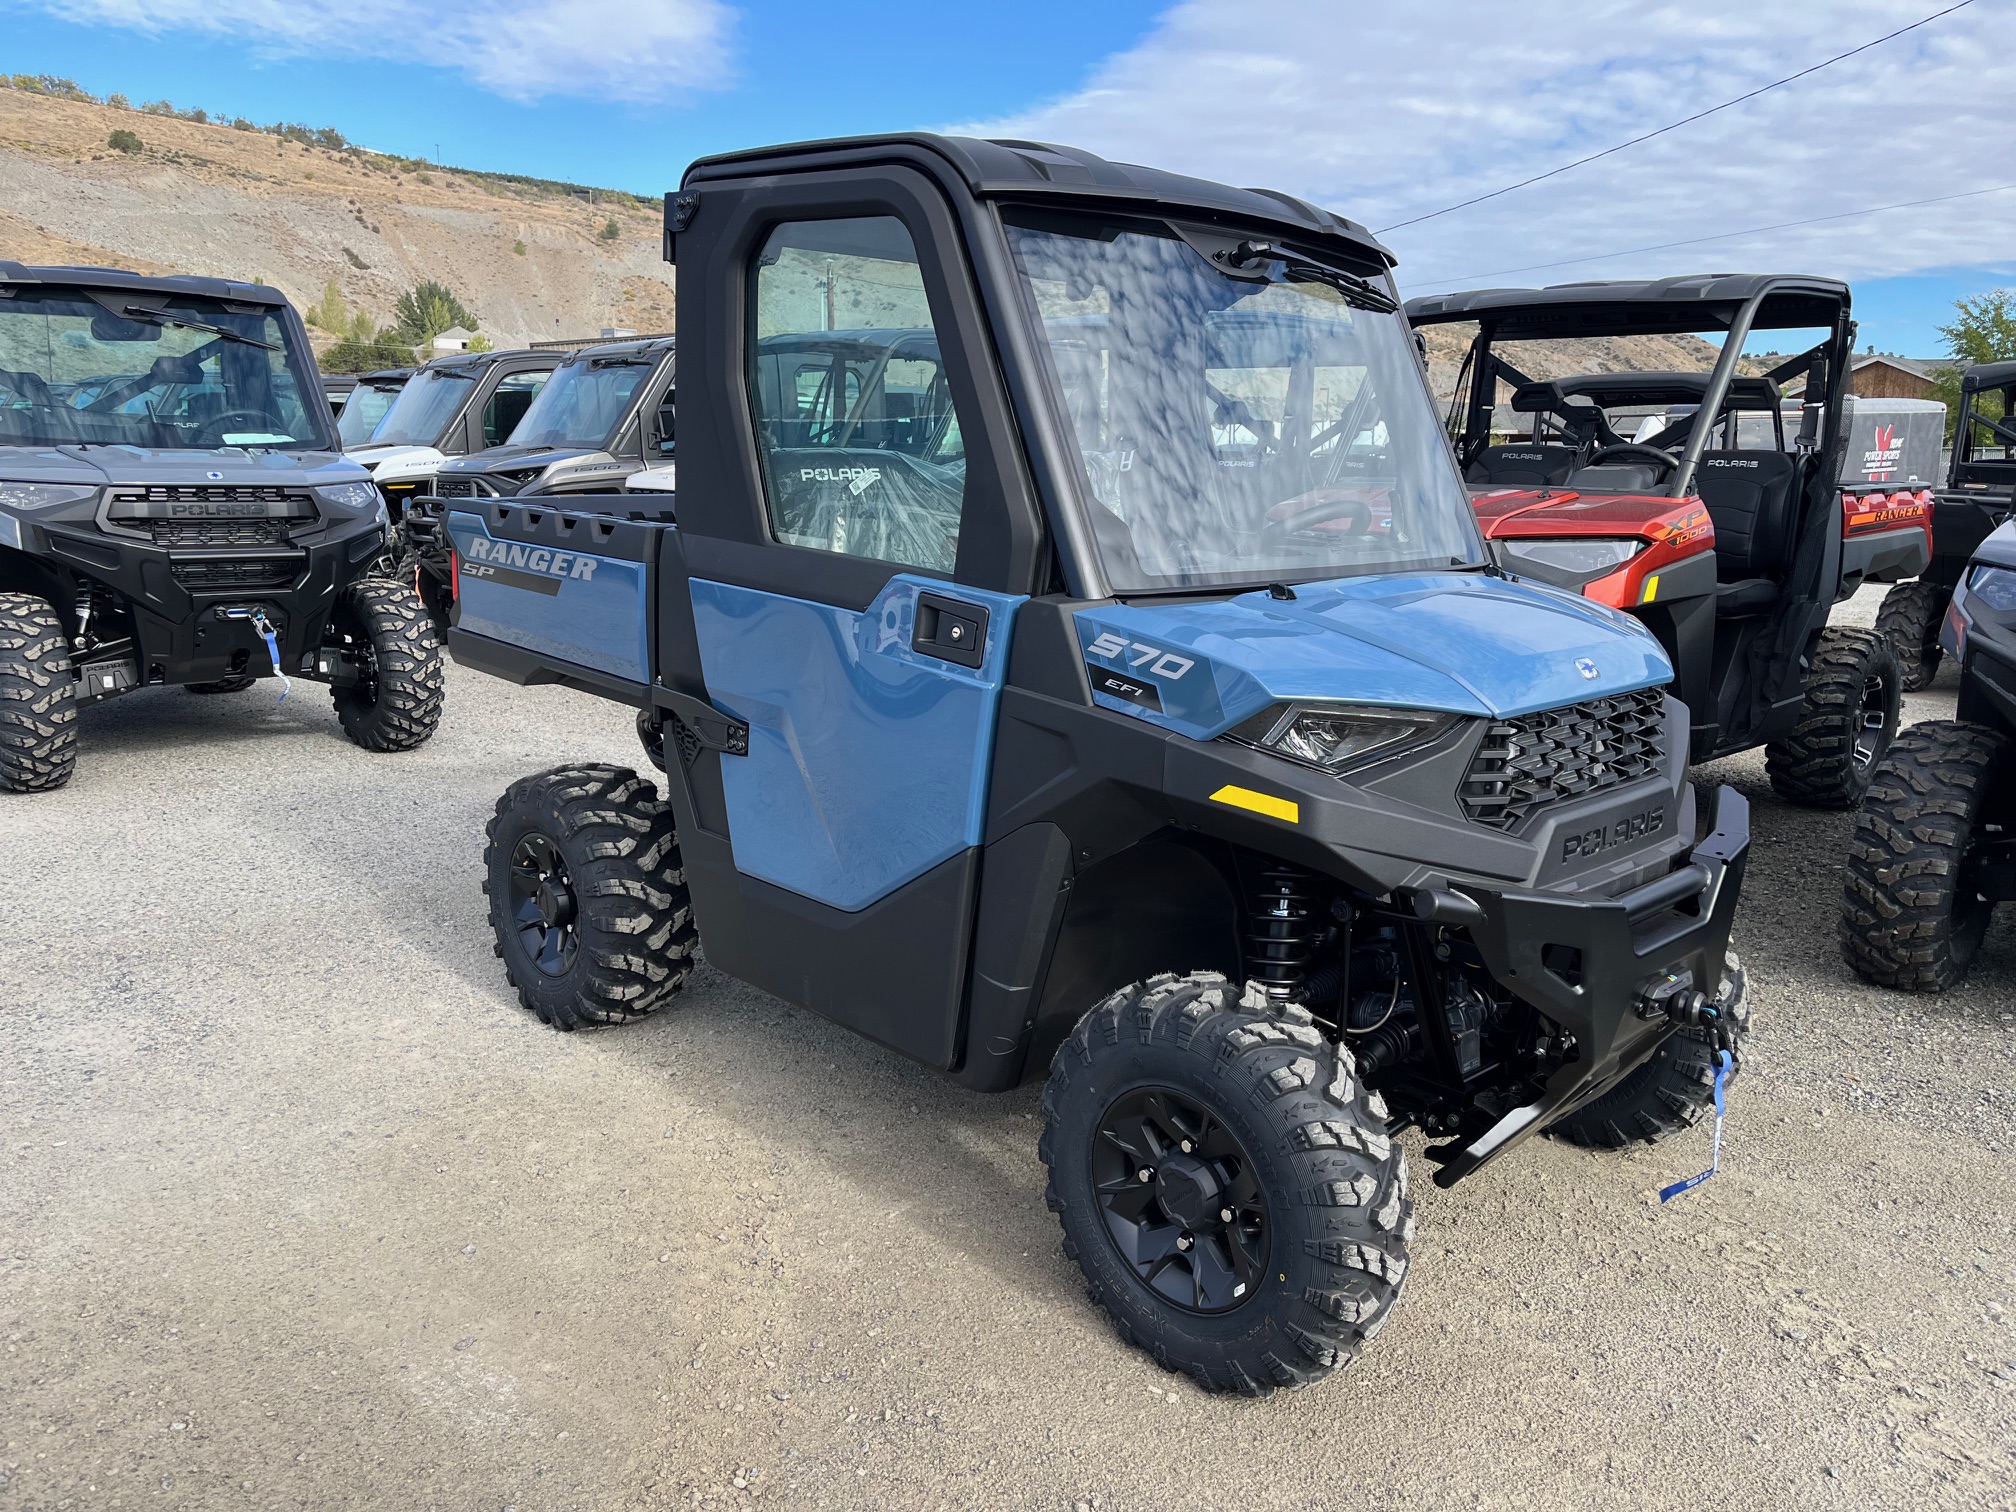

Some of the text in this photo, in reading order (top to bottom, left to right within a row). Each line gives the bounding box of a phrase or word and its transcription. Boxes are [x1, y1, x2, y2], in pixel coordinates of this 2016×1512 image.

[1501, 452, 1543, 461] POLARIS
[1707, 459, 1759, 468] POLARIS
[1863, 450, 1882, 462] POWER
[574, 464, 622, 473] 1500
[171, 504, 265, 516] POLARIS
[1874, 504, 1920, 522] RANGER
[1664, 508, 1705, 539] XP
[1676, 525, 1708, 545] 1000
[468, 537, 598, 582] RANGER
[461, 562, 496, 577] SP
[1086, 632, 1195, 680] 570
[1104, 678, 1144, 696] EFI
[1561, 805, 1664, 866] POLARIS
